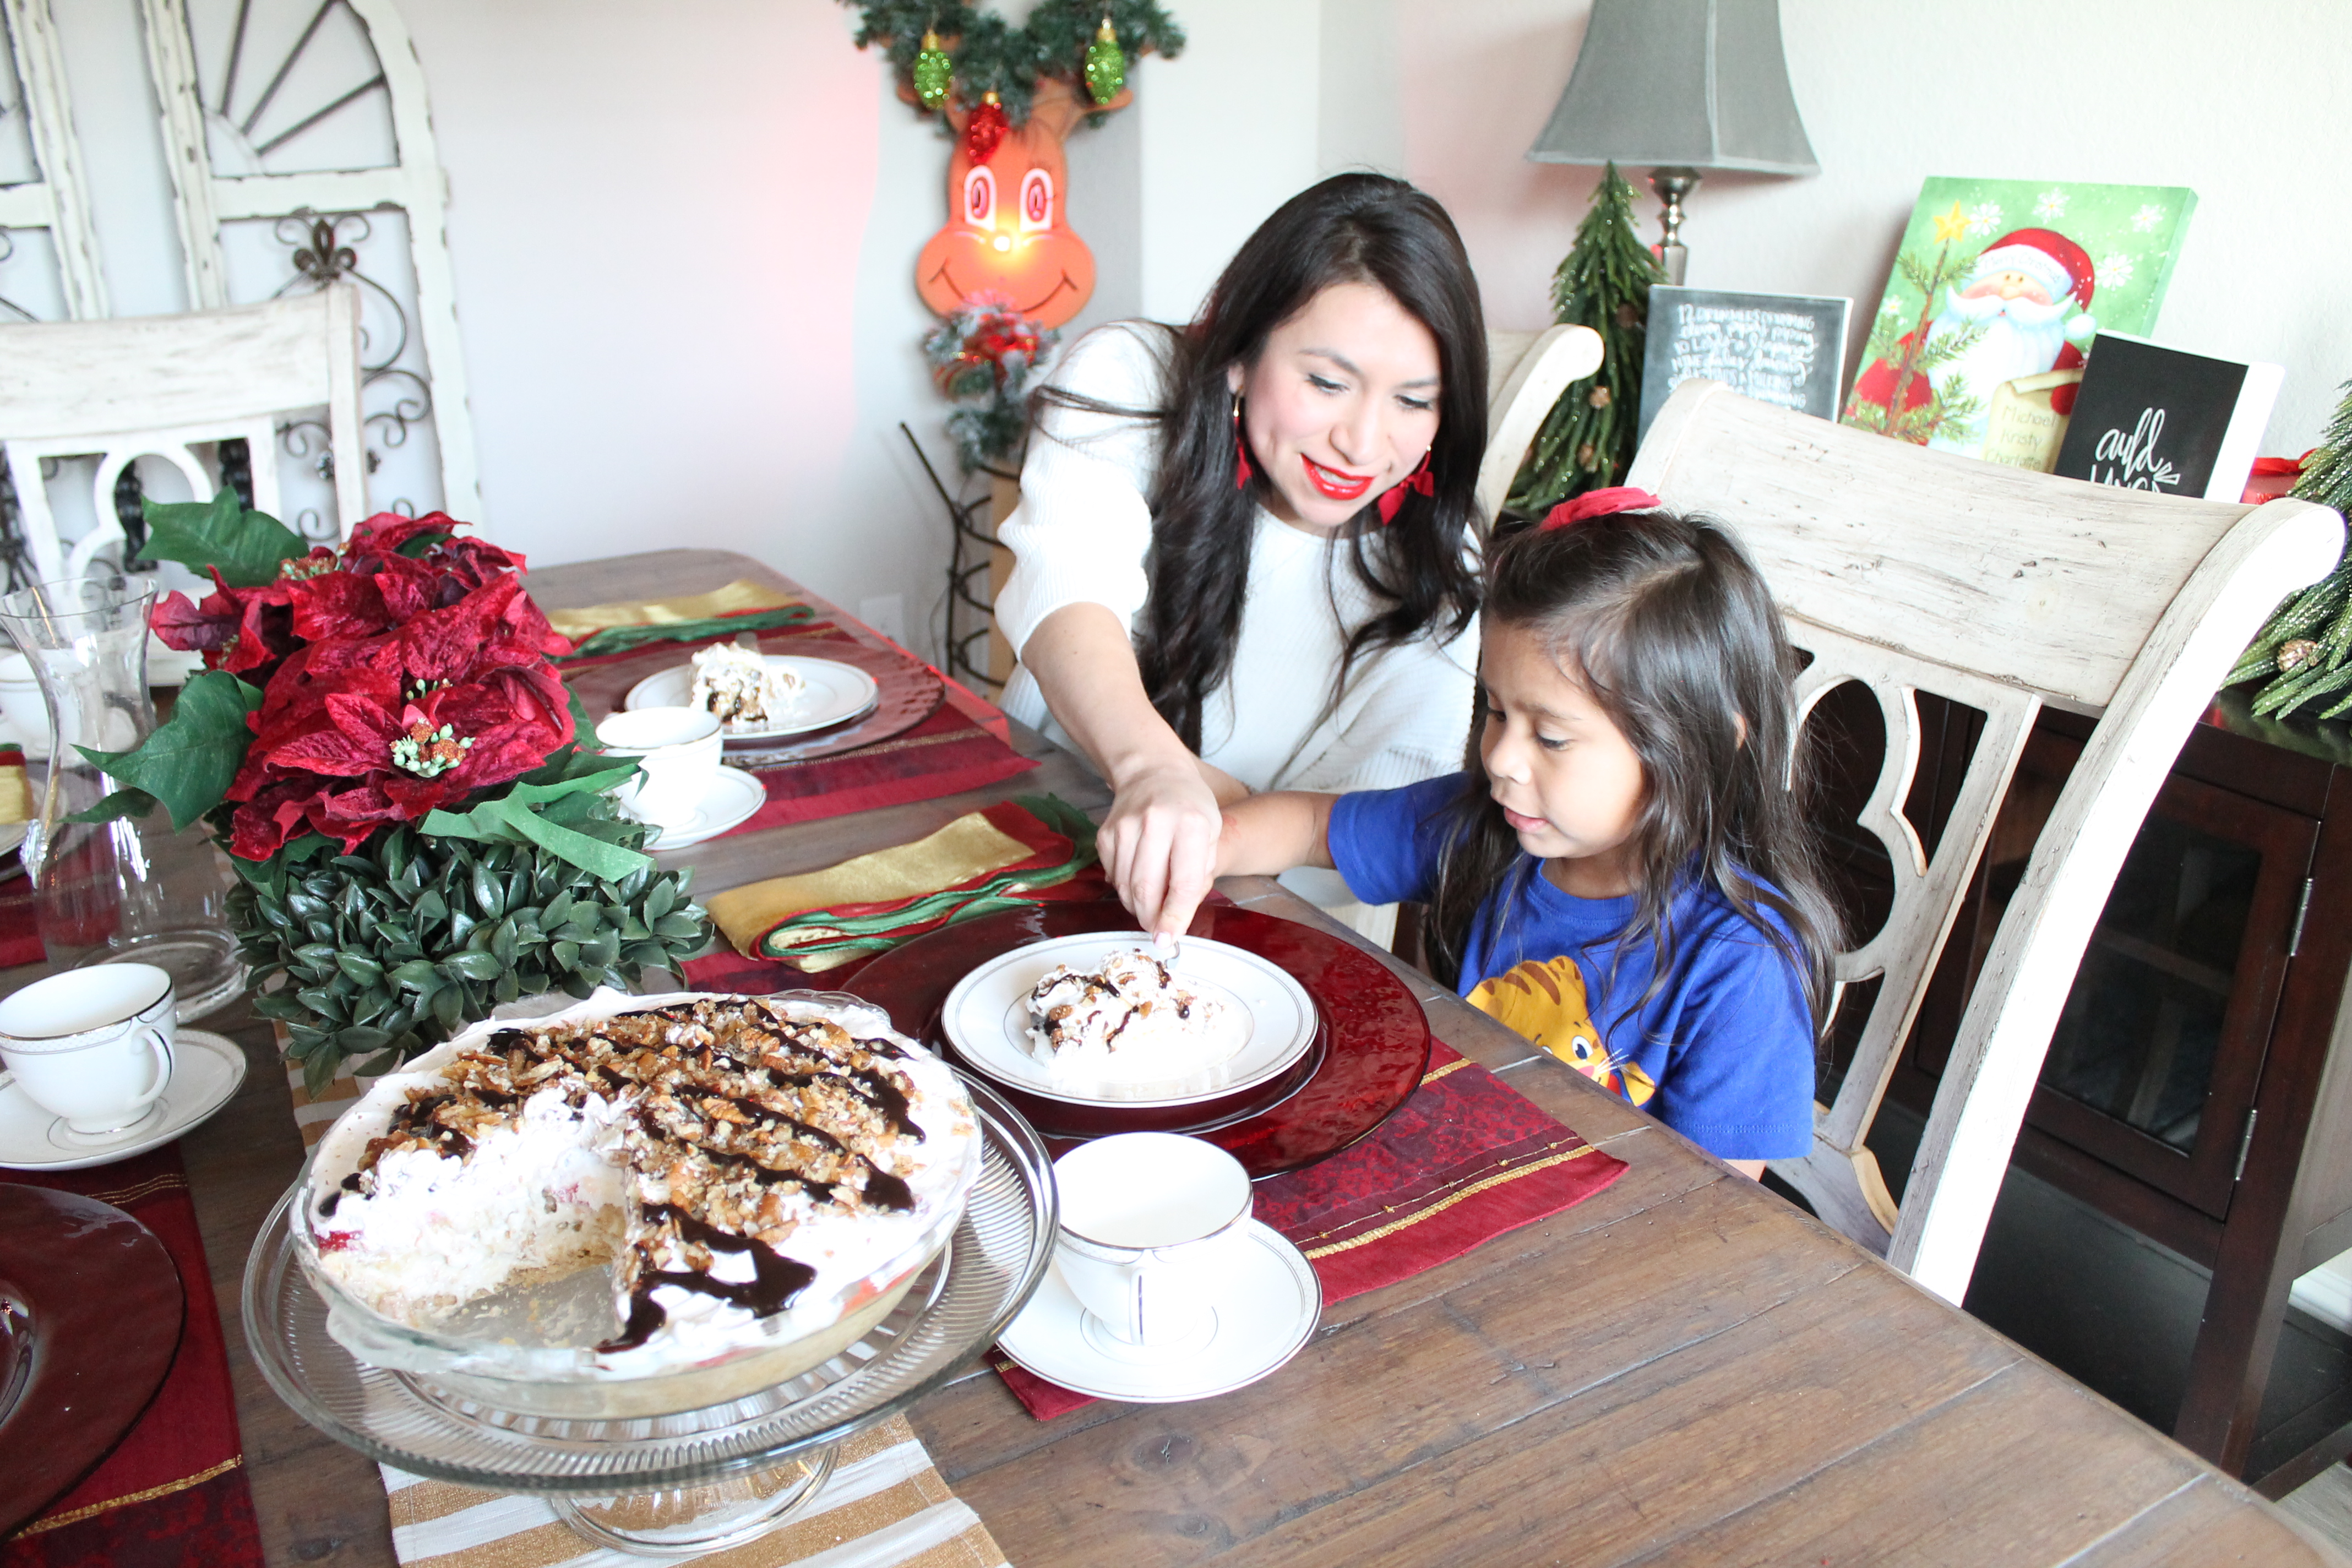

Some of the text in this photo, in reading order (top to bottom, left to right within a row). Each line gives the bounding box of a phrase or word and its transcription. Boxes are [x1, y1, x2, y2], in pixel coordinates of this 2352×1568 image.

[1677, 303, 1695, 325] 12
[1673, 340, 1690, 356] 10
[2001, 404, 2057, 428] Michael
[2094, 407, 2165, 482] auld
